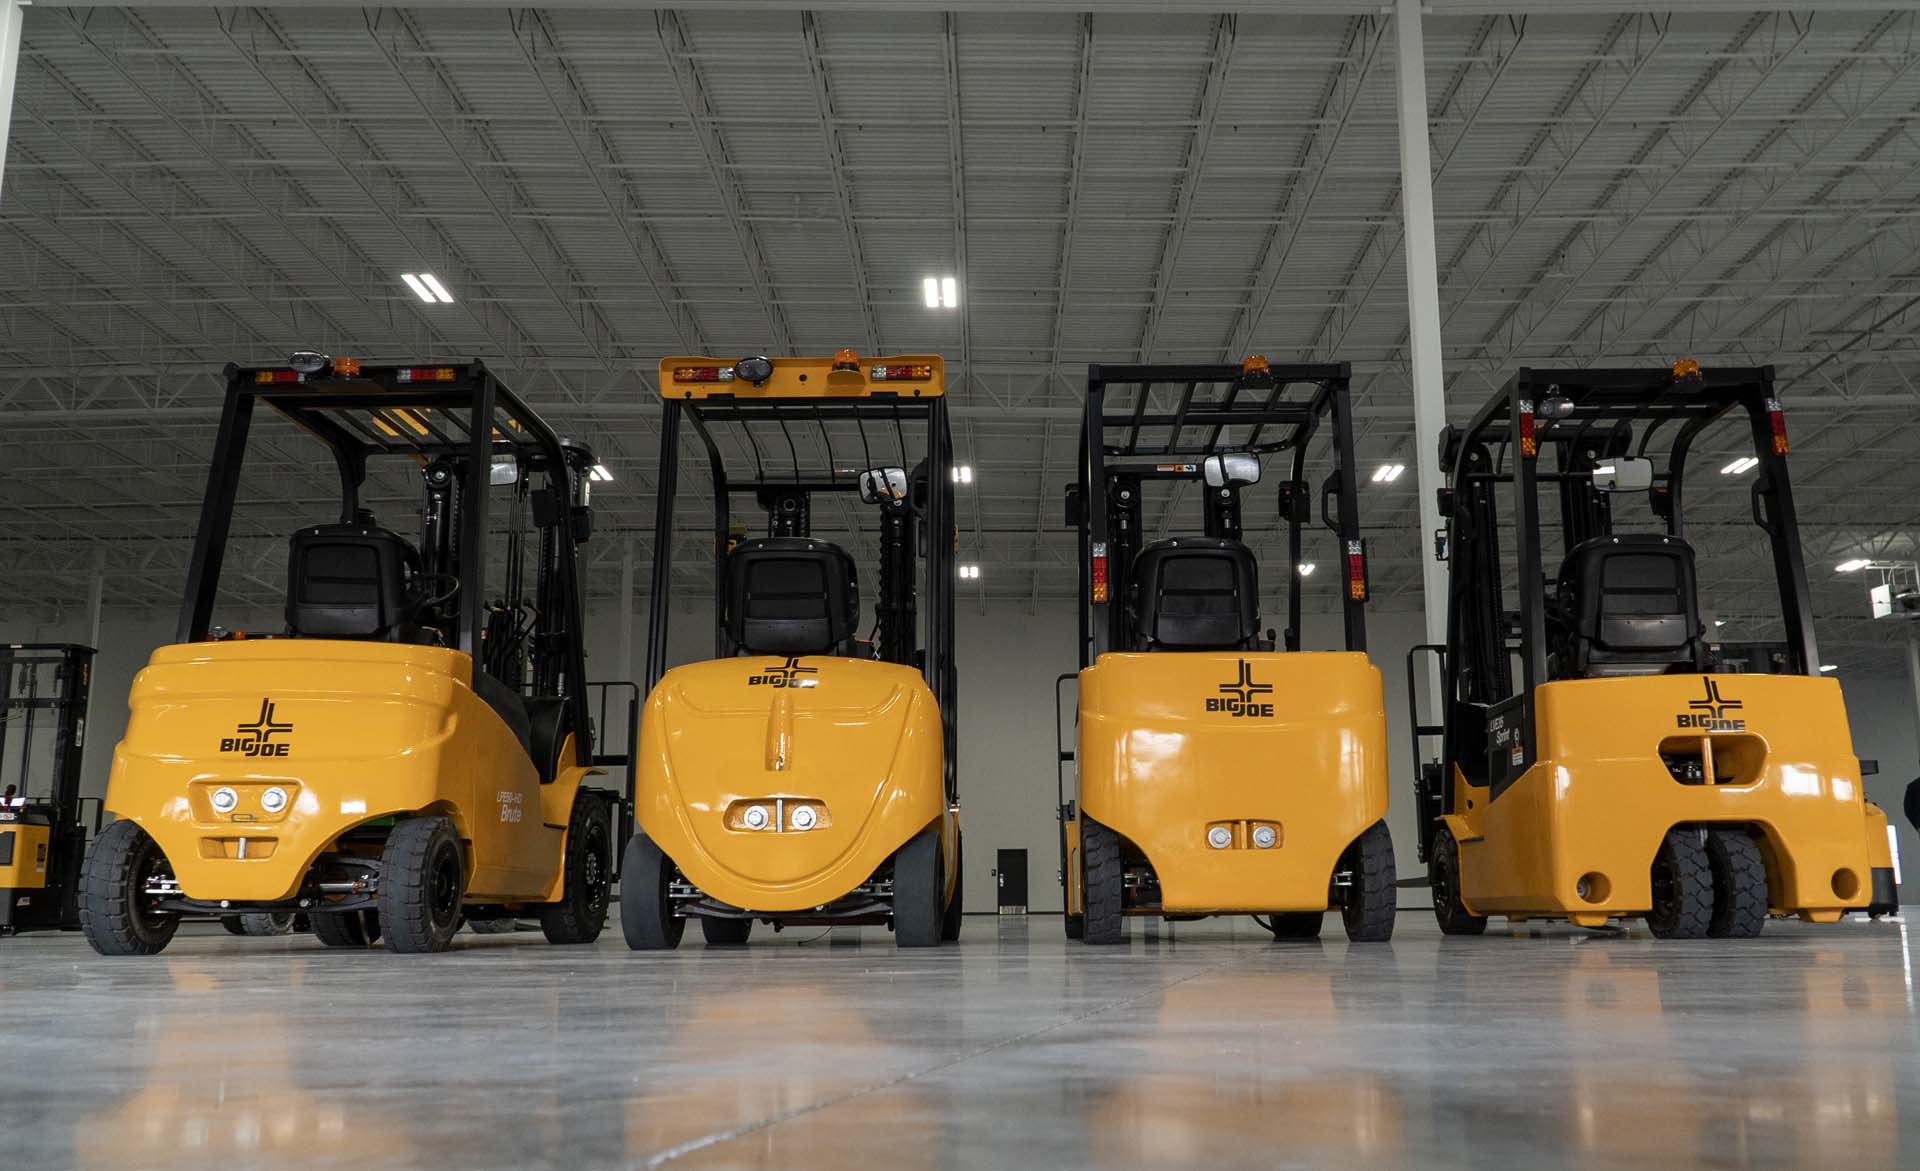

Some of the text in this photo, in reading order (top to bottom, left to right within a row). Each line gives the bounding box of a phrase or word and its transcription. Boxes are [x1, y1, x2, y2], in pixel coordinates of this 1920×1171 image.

[748, 675, 782, 685] BIG
[1206, 698, 1274, 717] BIG JOE
[1677, 714, 1711, 728] BIG
[220, 738, 290, 756] BIG JOE
[501, 804, 521, 822] Brute
